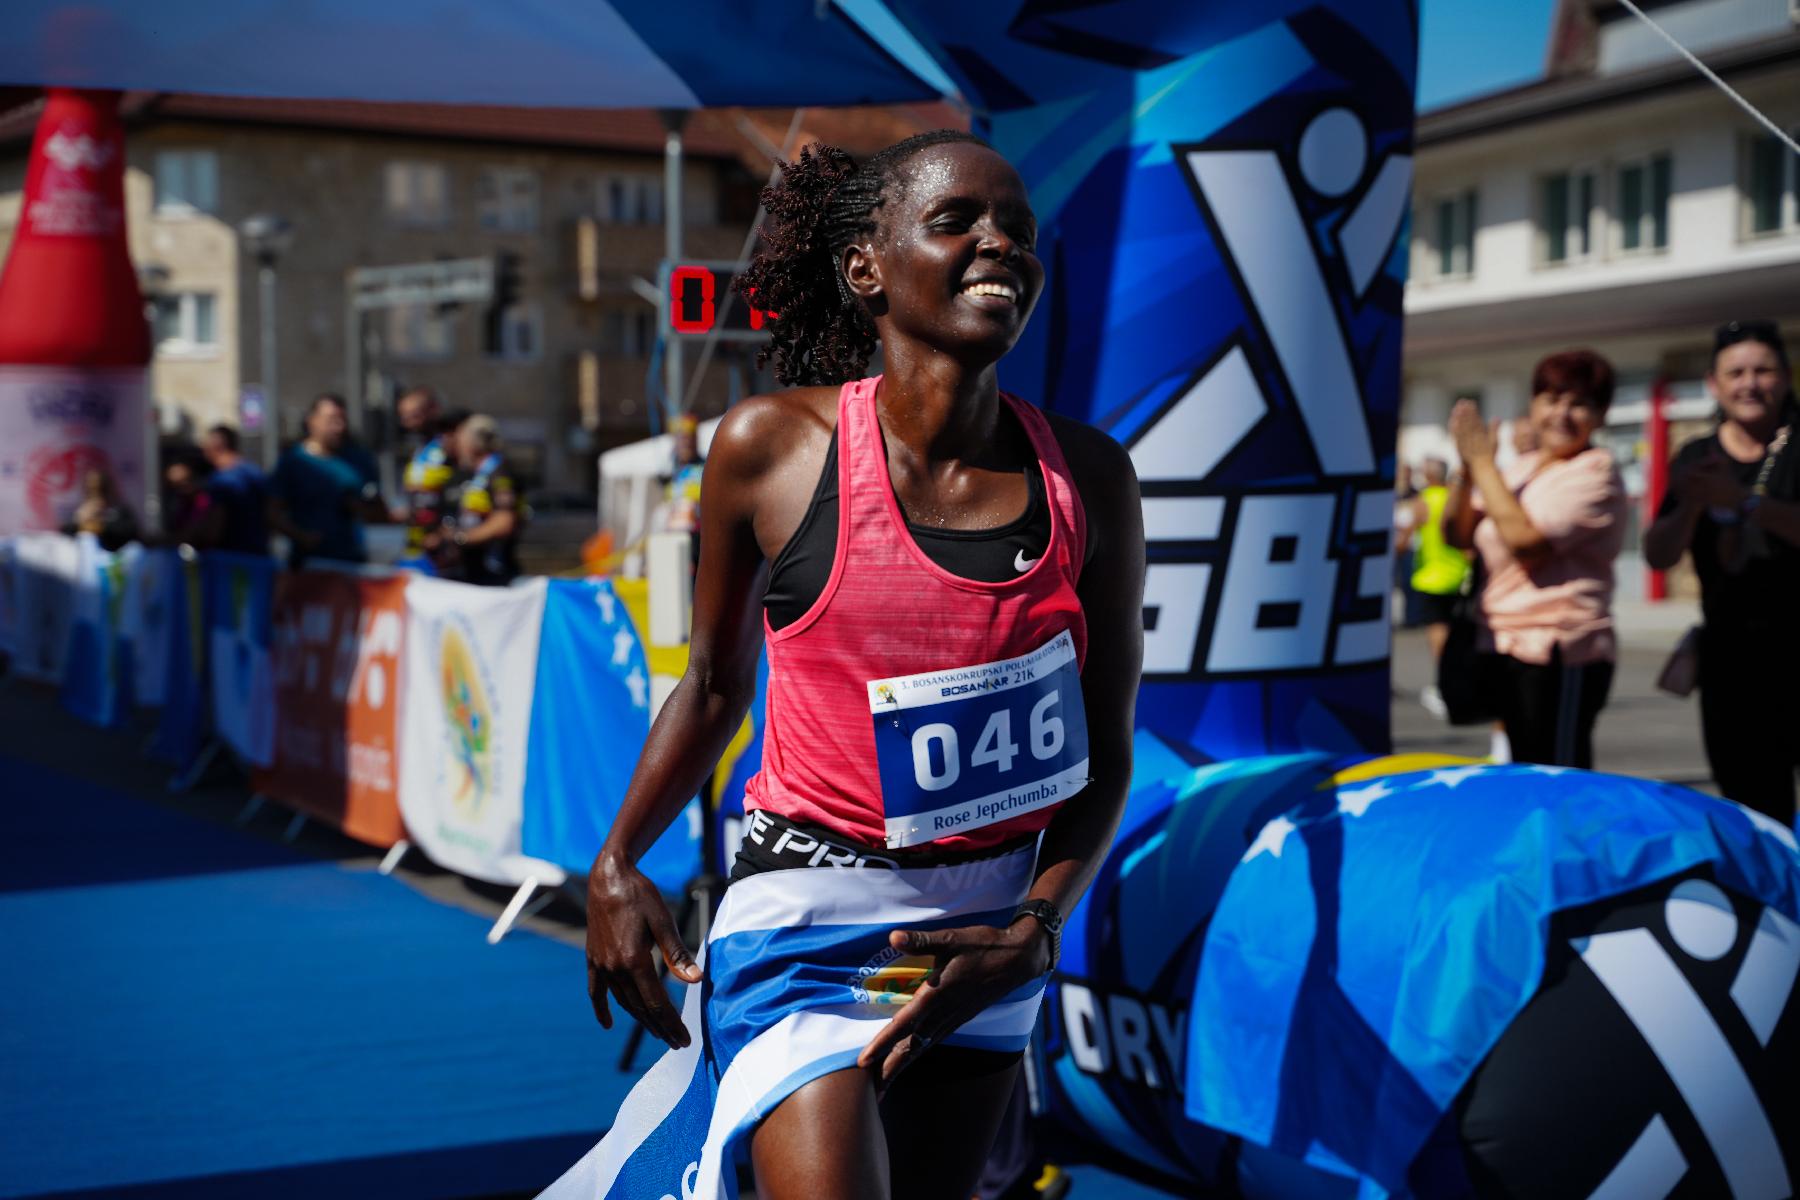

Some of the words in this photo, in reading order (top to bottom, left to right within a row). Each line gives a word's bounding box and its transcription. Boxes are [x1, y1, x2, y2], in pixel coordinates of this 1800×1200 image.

[912, 665, 1003, 689] BOSANSKOKRUPSKI
[1014, 667, 1035, 684] 21K
[911, 689, 1065, 792] 046
[933, 808, 971, 831] Rose
[975, 783, 1058, 819] Jepchumba
[772, 828, 900, 884] PRO
